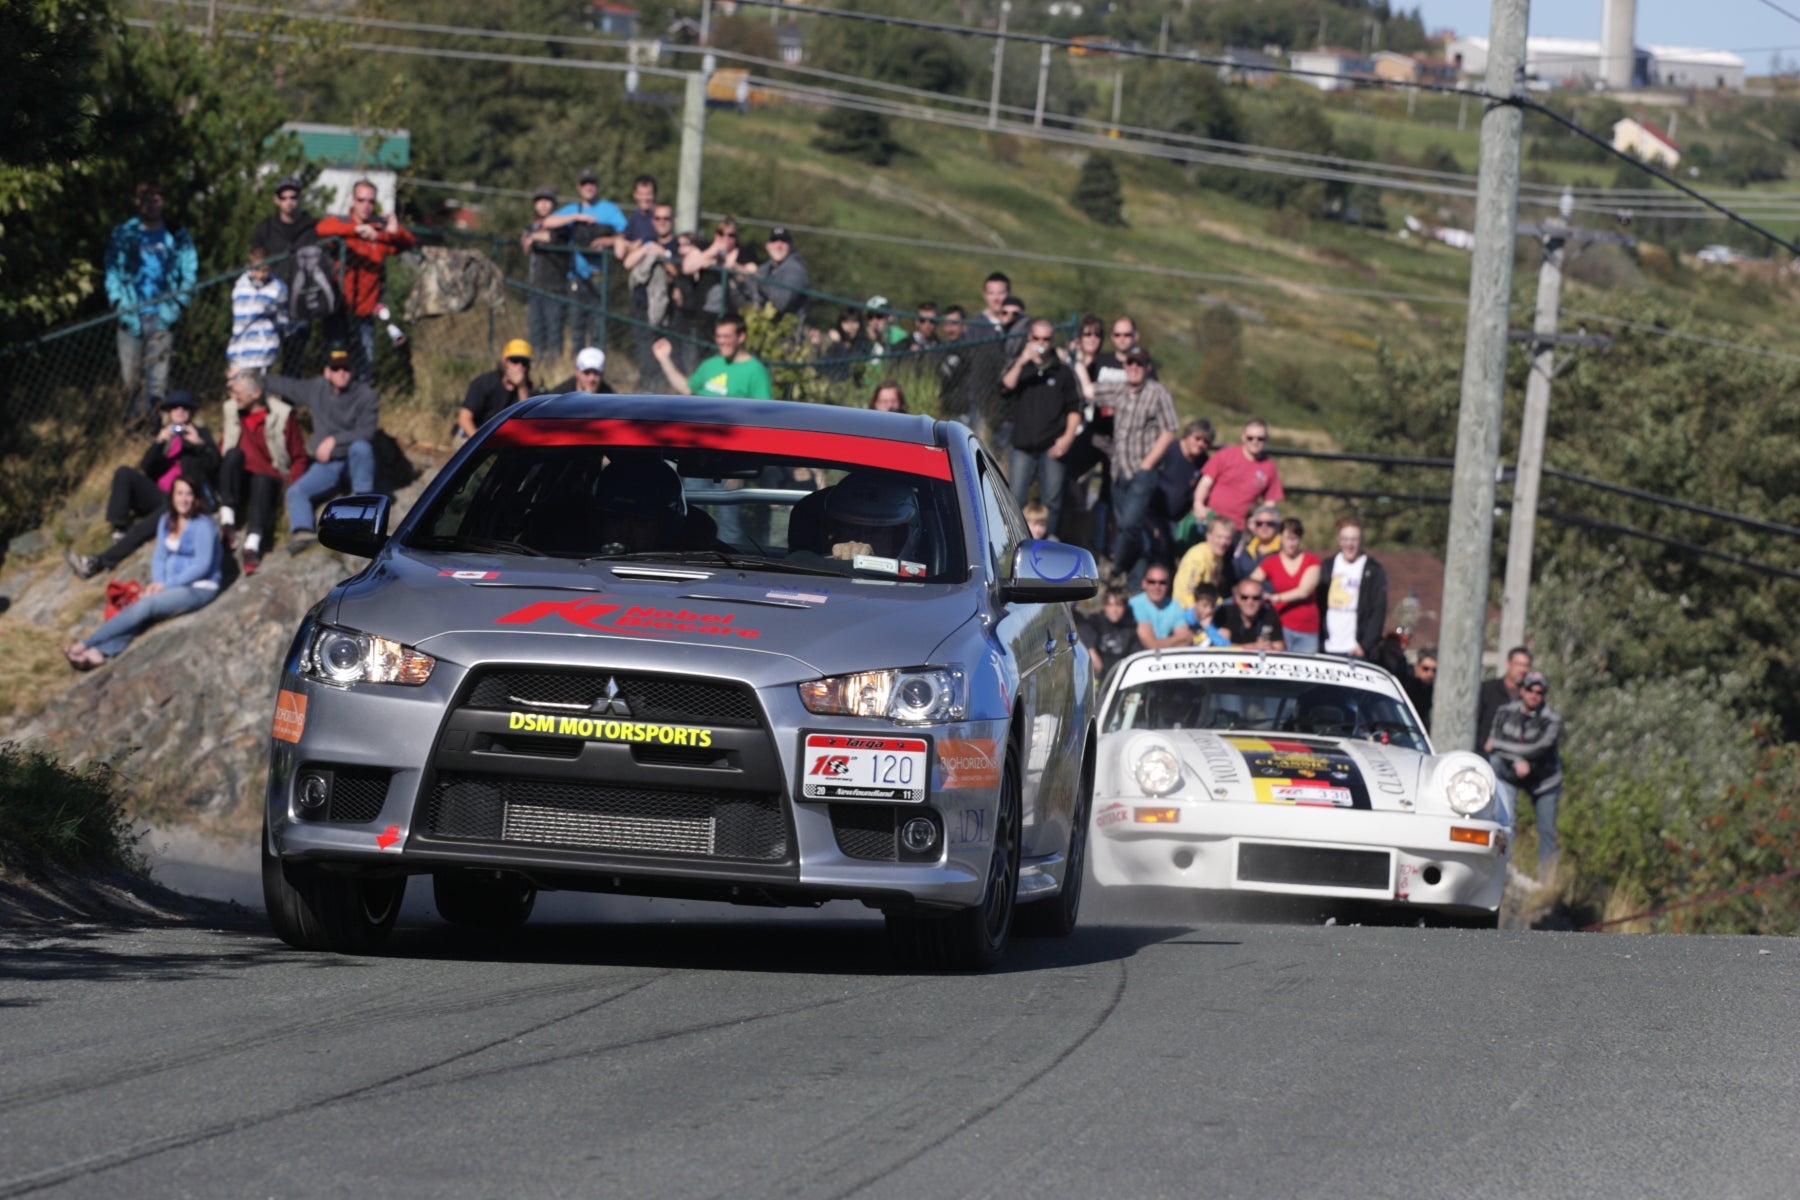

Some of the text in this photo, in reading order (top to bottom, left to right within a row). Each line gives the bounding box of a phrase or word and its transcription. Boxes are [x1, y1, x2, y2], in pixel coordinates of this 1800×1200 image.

[613, 615, 761, 639] Biocare
[624, 605, 736, 625] Nobel
[1148, 660, 1376, 684] GERMAN EXCELLENCE
[509, 711, 712, 748] DSM MOTORSPORTS
[845, 737, 885, 750] Targa
[872, 754, 913, 785] 120
[815, 786, 911, 799] 20 Newfoundland 11
